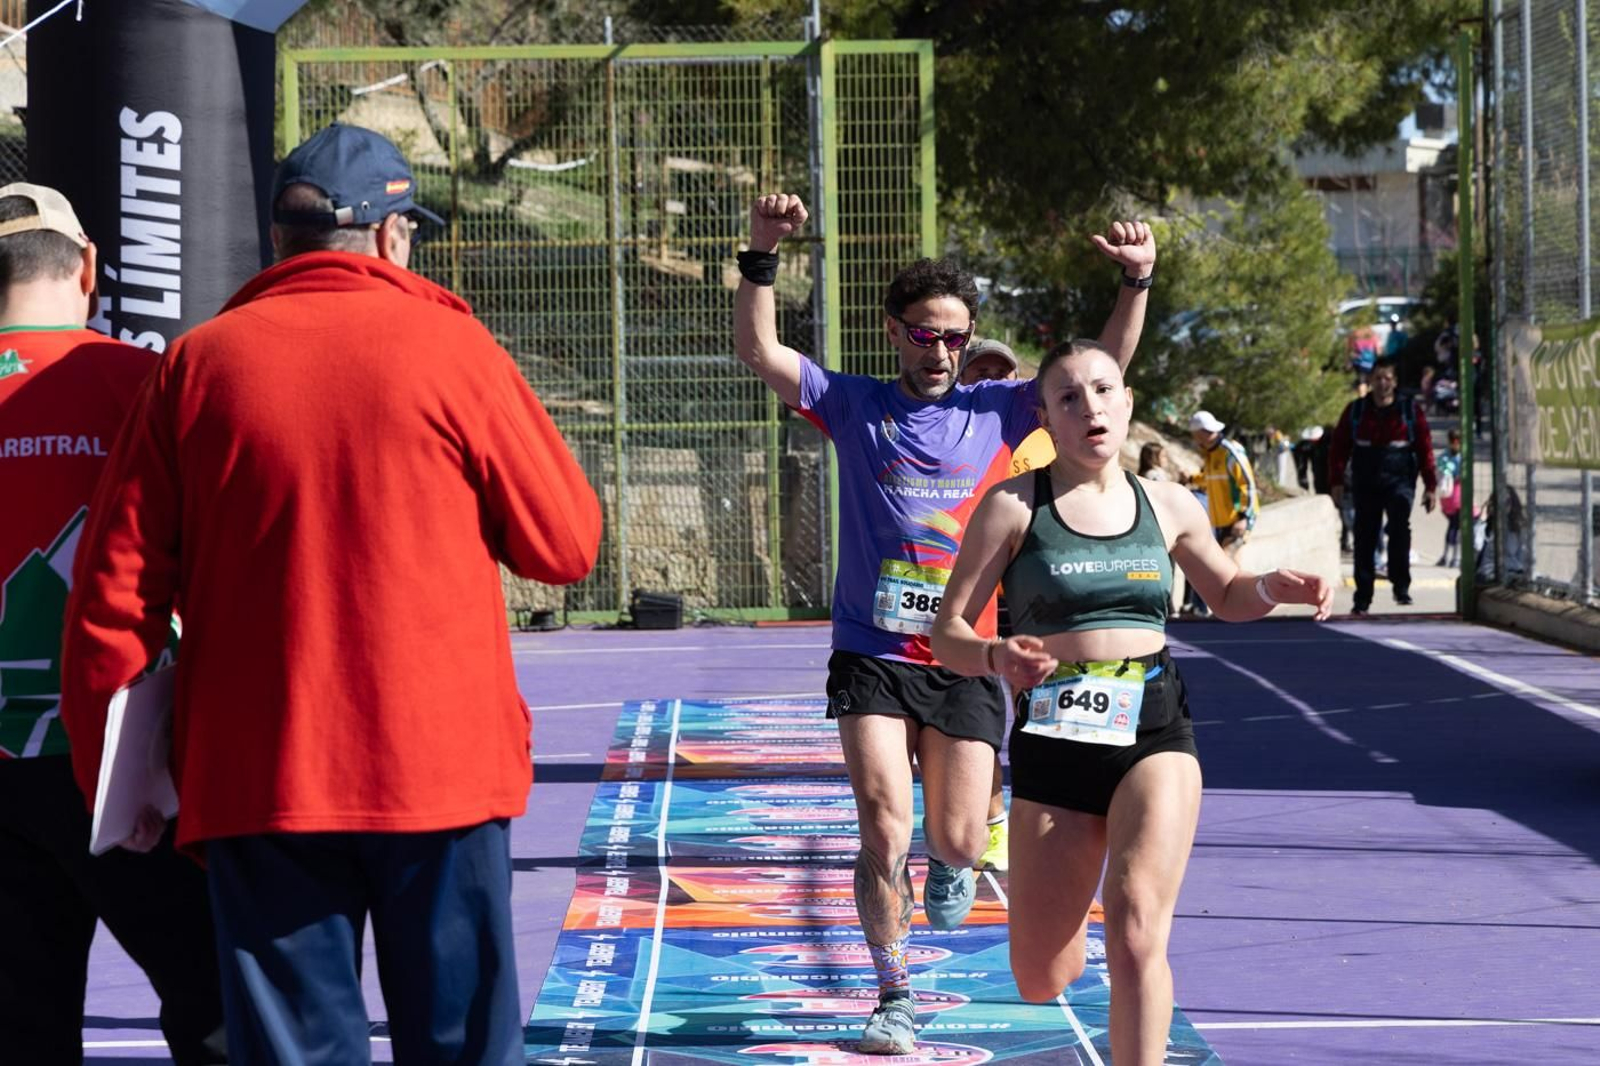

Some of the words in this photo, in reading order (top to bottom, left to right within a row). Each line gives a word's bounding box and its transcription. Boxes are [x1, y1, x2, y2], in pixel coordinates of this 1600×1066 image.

[104, 106, 183, 320] LÍMITES
[0, 435, 108, 458] RBITRAL
[943, 488, 975, 499] REAL
[1050, 559, 1159, 576] LOVEBURPEES
[901, 591, 943, 614] 388
[1057, 689, 1110, 714] 649
